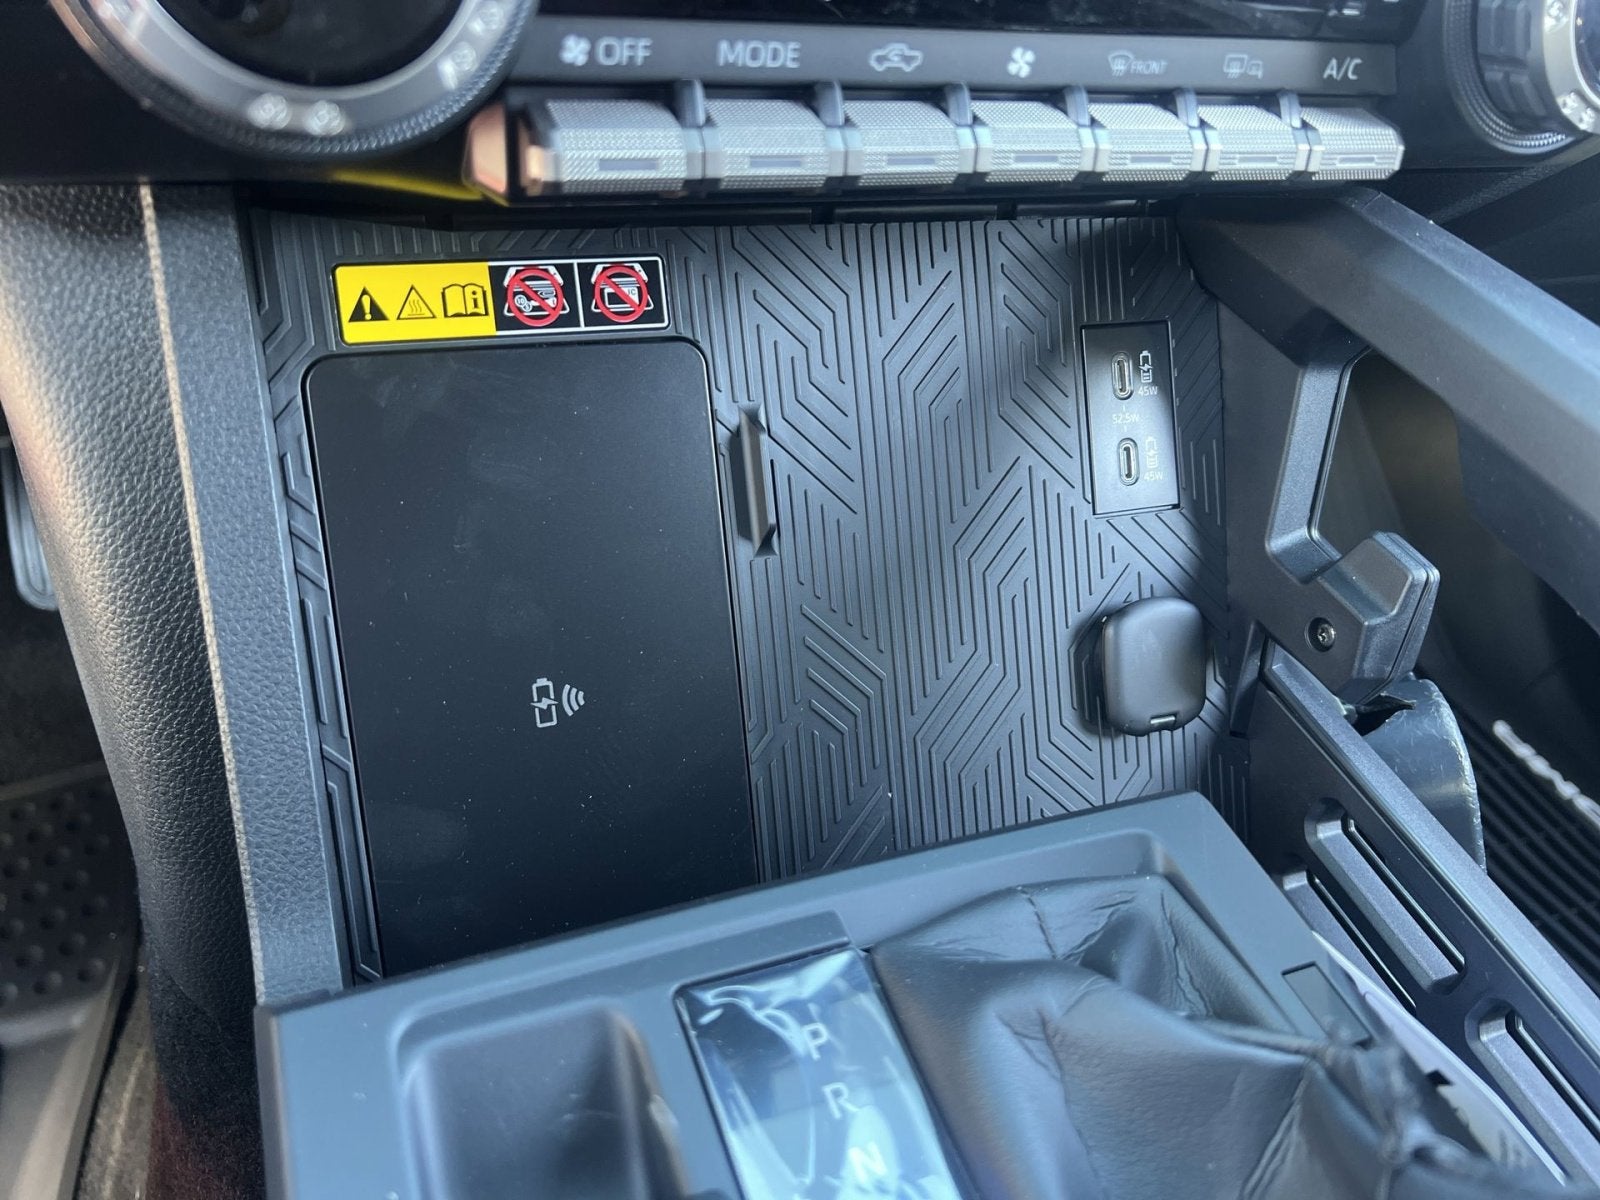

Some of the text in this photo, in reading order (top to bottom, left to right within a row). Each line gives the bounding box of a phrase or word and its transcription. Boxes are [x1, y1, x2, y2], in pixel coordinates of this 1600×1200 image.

[596, 36, 652, 66] OFF
[716, 39, 801, 69] MODE
[1130, 59, 1168, 75] FRONT
[1322, 57, 1363, 81] A/C
[1138, 385, 1158, 397] 45W
[1143, 471, 1163, 481] 45W
[802, 1022, 828, 1061] P
[822, 1082, 860, 1119] R
